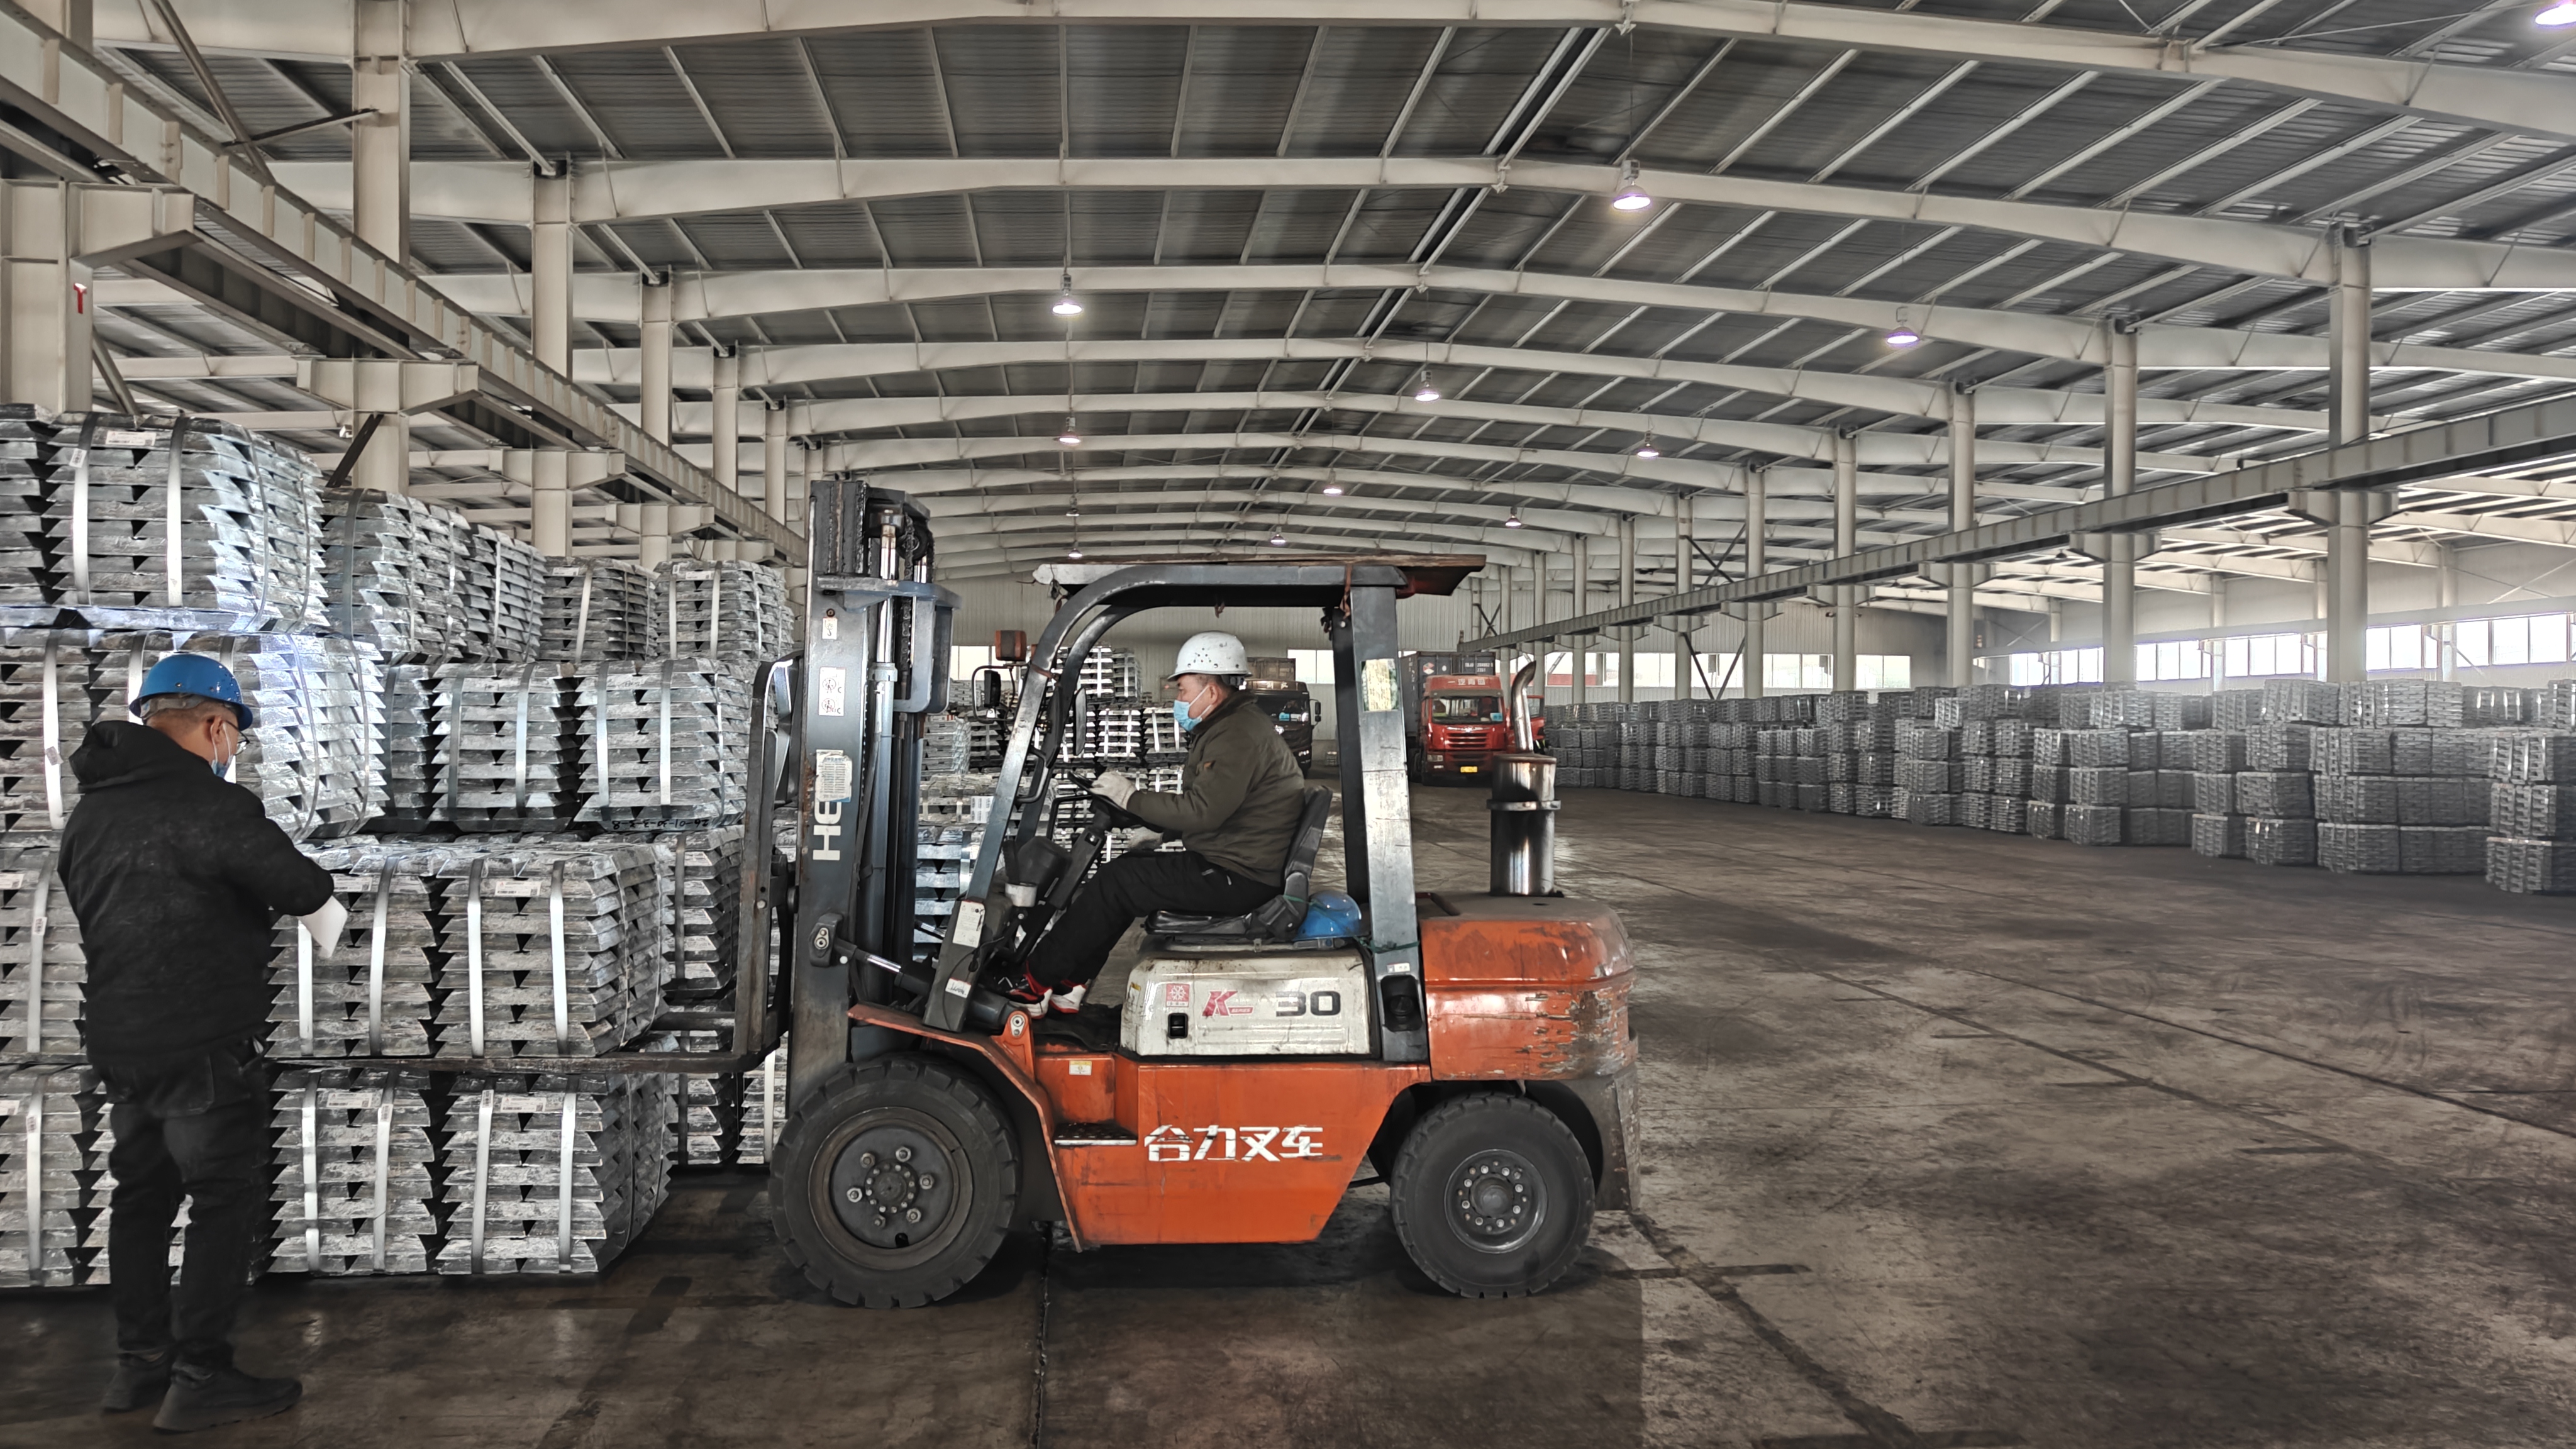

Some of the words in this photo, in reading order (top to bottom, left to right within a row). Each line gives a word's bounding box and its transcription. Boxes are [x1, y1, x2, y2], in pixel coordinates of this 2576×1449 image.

[1275, 990, 1341, 1017] 30
[1144, 1124, 1324, 1162] 合力叉车
